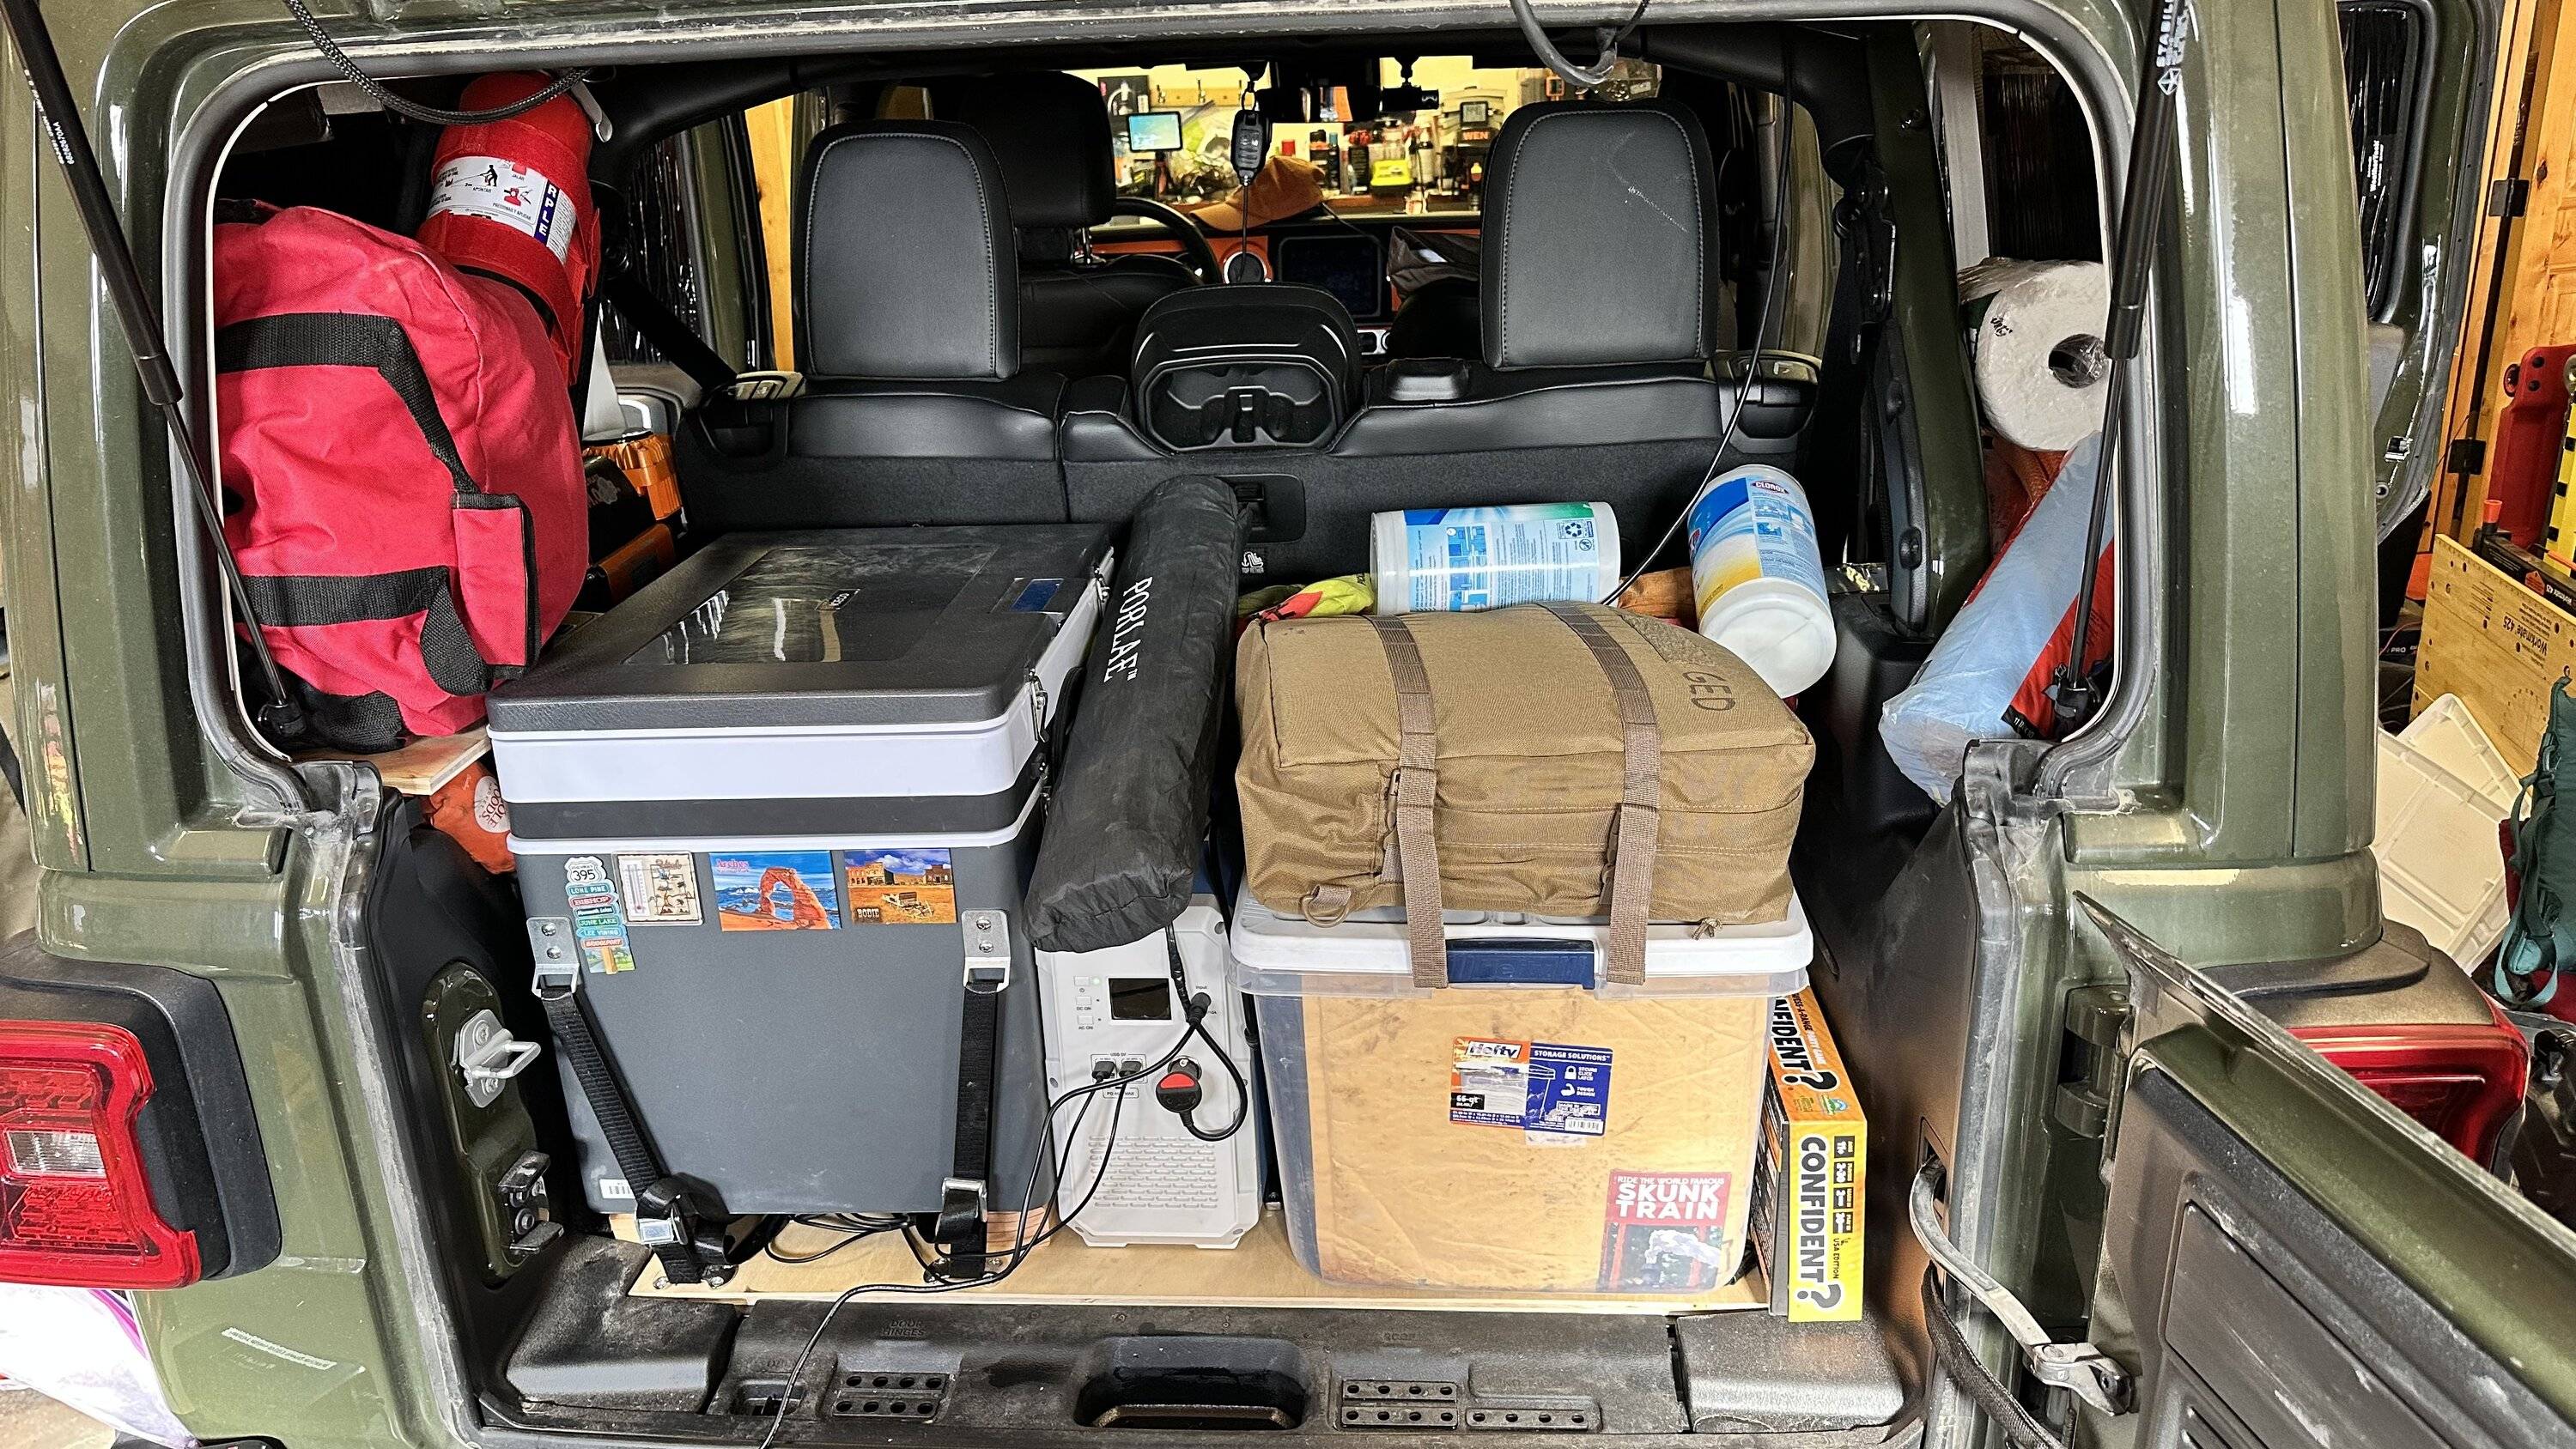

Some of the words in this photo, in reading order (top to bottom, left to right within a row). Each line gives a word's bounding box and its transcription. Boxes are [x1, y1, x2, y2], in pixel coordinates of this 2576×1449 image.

[2156, 0, 2173, 67] STABIL
[1463, 130, 1490, 140] WEN
[1755, 481, 1786, 494] CLOROX
[2503, 615, 2515, 632] 425
[1682, 671, 1736, 711] GED
[488, 798, 507, 828] OLE
[716, 858, 750, 868] Arches
[573, 869, 596, 881] 395
[570, 886, 589, 894] LONE
[590, 884, 606, 893] PINE
[857, 908, 879, 918] BODIE
[1534, 1050, 1567, 1058] STORAGE
[1617, 1183, 1722, 1202] SKUNK
[1615, 1200, 1719, 1220] TRAIN
[1796, 1137, 1842, 1309] CONFIDENT?
